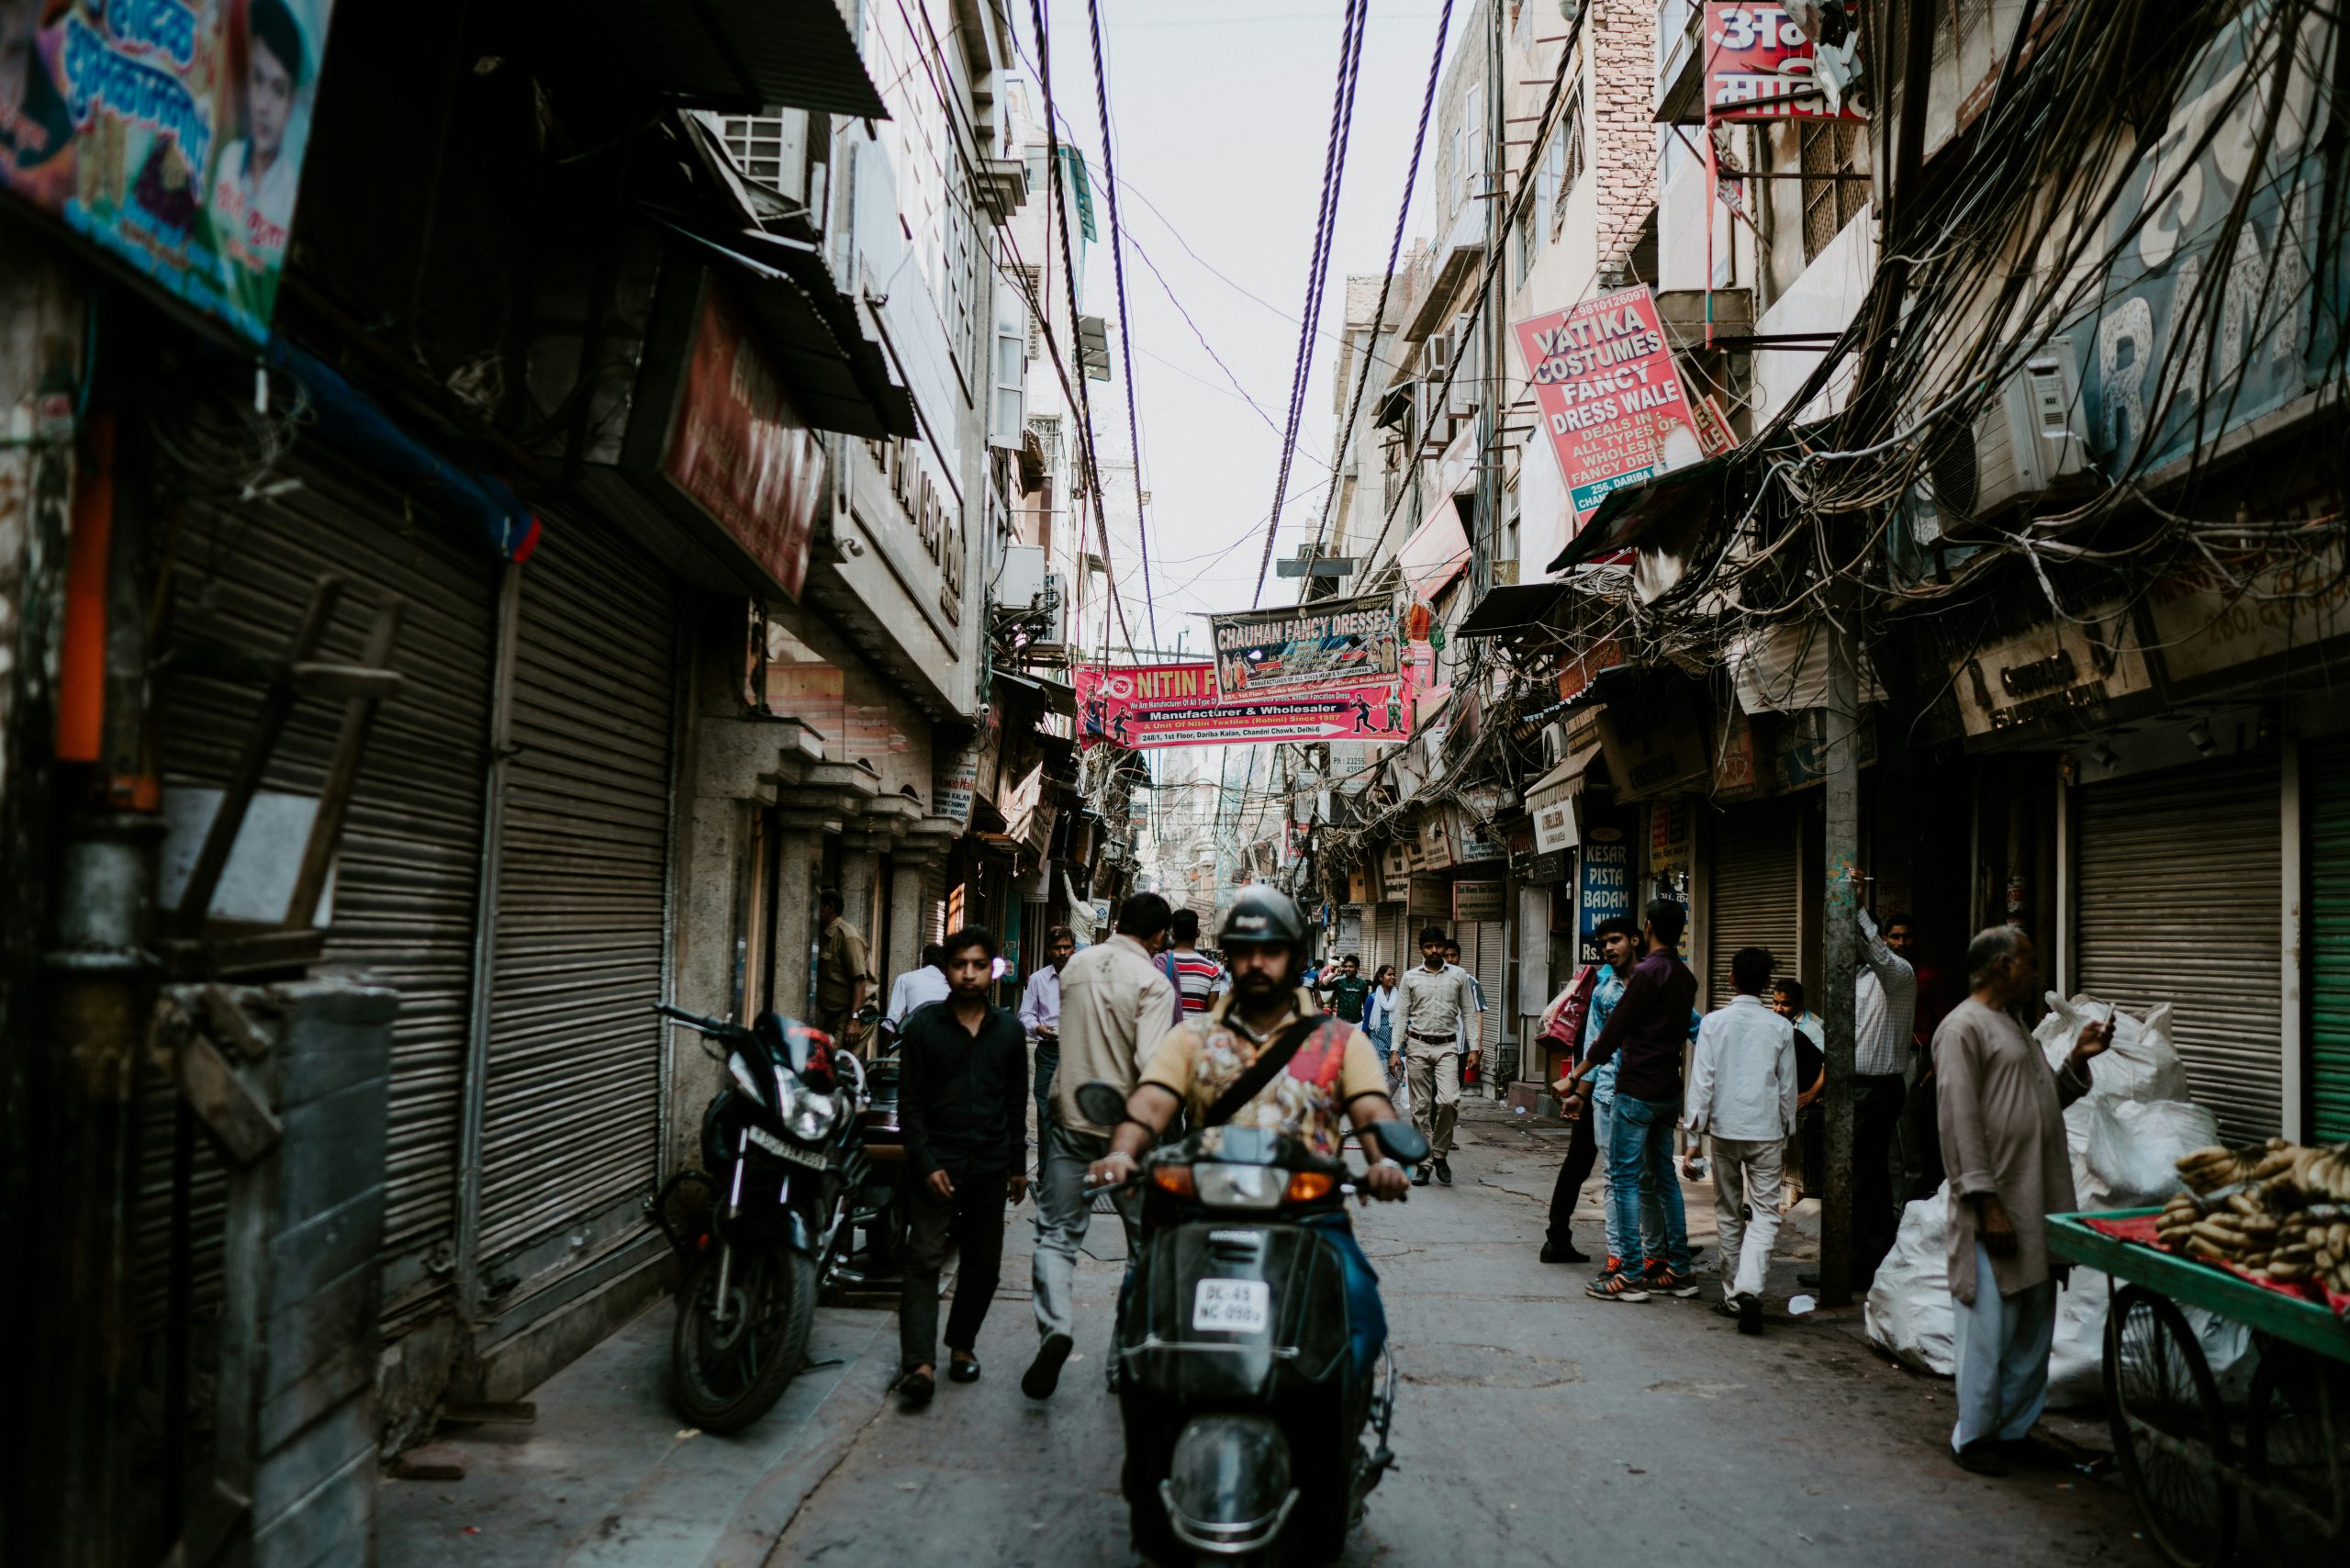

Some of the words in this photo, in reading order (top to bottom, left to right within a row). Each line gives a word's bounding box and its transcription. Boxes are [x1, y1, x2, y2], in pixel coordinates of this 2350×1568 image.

[1579, 288, 1646, 317] 9810126097
[1532, 305, 1646, 357] VATIKA
[1534, 330, 1662, 384] COSTUMES
[1561, 360, 1649, 406] FANCY
[1551, 398, 1618, 435] DRESS
[1619, 379, 1679, 413] WALE
[1582, 418, 1631, 442] DEALS
[1573, 442, 1603, 458] ALL
[1605, 426, 1655, 448] TYPES
[1572, 460, 1621, 485] FANCY
[1614, 470, 1651, 488] DARIBA
[1217, 622, 1283, 651] CHAUHAN
[1285, 616, 1330, 643] FANCY
[1332, 609, 1390, 637] DRESSES
[1137, 669, 1197, 700] NITIN
[1250, 678, 1286, 687] MANUFACTURES
[1130, 701, 1139, 710] We
[1139, 700, 1148, 709] Are
[1148, 699, 1182, 709] Manufacturer
[1198, 698, 1211, 707] Type
[1211, 697, 1217, 706] Of
[1310, 692, 1335, 700] Fancation
[1336, 691, 1350, 700] Dress
[1150, 708, 1242, 721] Manufacturer
[1246, 706, 1256, 716] &
[1260, 704, 1337, 715] Wholesaler
[1174, 721, 1185, 729] Of
[1213, 718, 1248, 726] Textiles
[1251, 716, 1287, 725] (Rohini)
[1176, 732, 1195, 741] Floor,
[1196, 731, 1218, 739] Dariba
[1220, 729, 1241, 738] Kalan,
[1243, 728, 1270, 736] Chandni
[1270, 726, 1295, 734] Chowk,
[1333, 756, 1341, 765] Ph
[951, 792, 971, 801] KALAN
[1586, 845, 1628, 864] KESAR
[1589, 868, 1624, 886] PISTA
[1583, 890, 1629, 909] BADAM
[1582, 943, 1601, 961] Rs.
